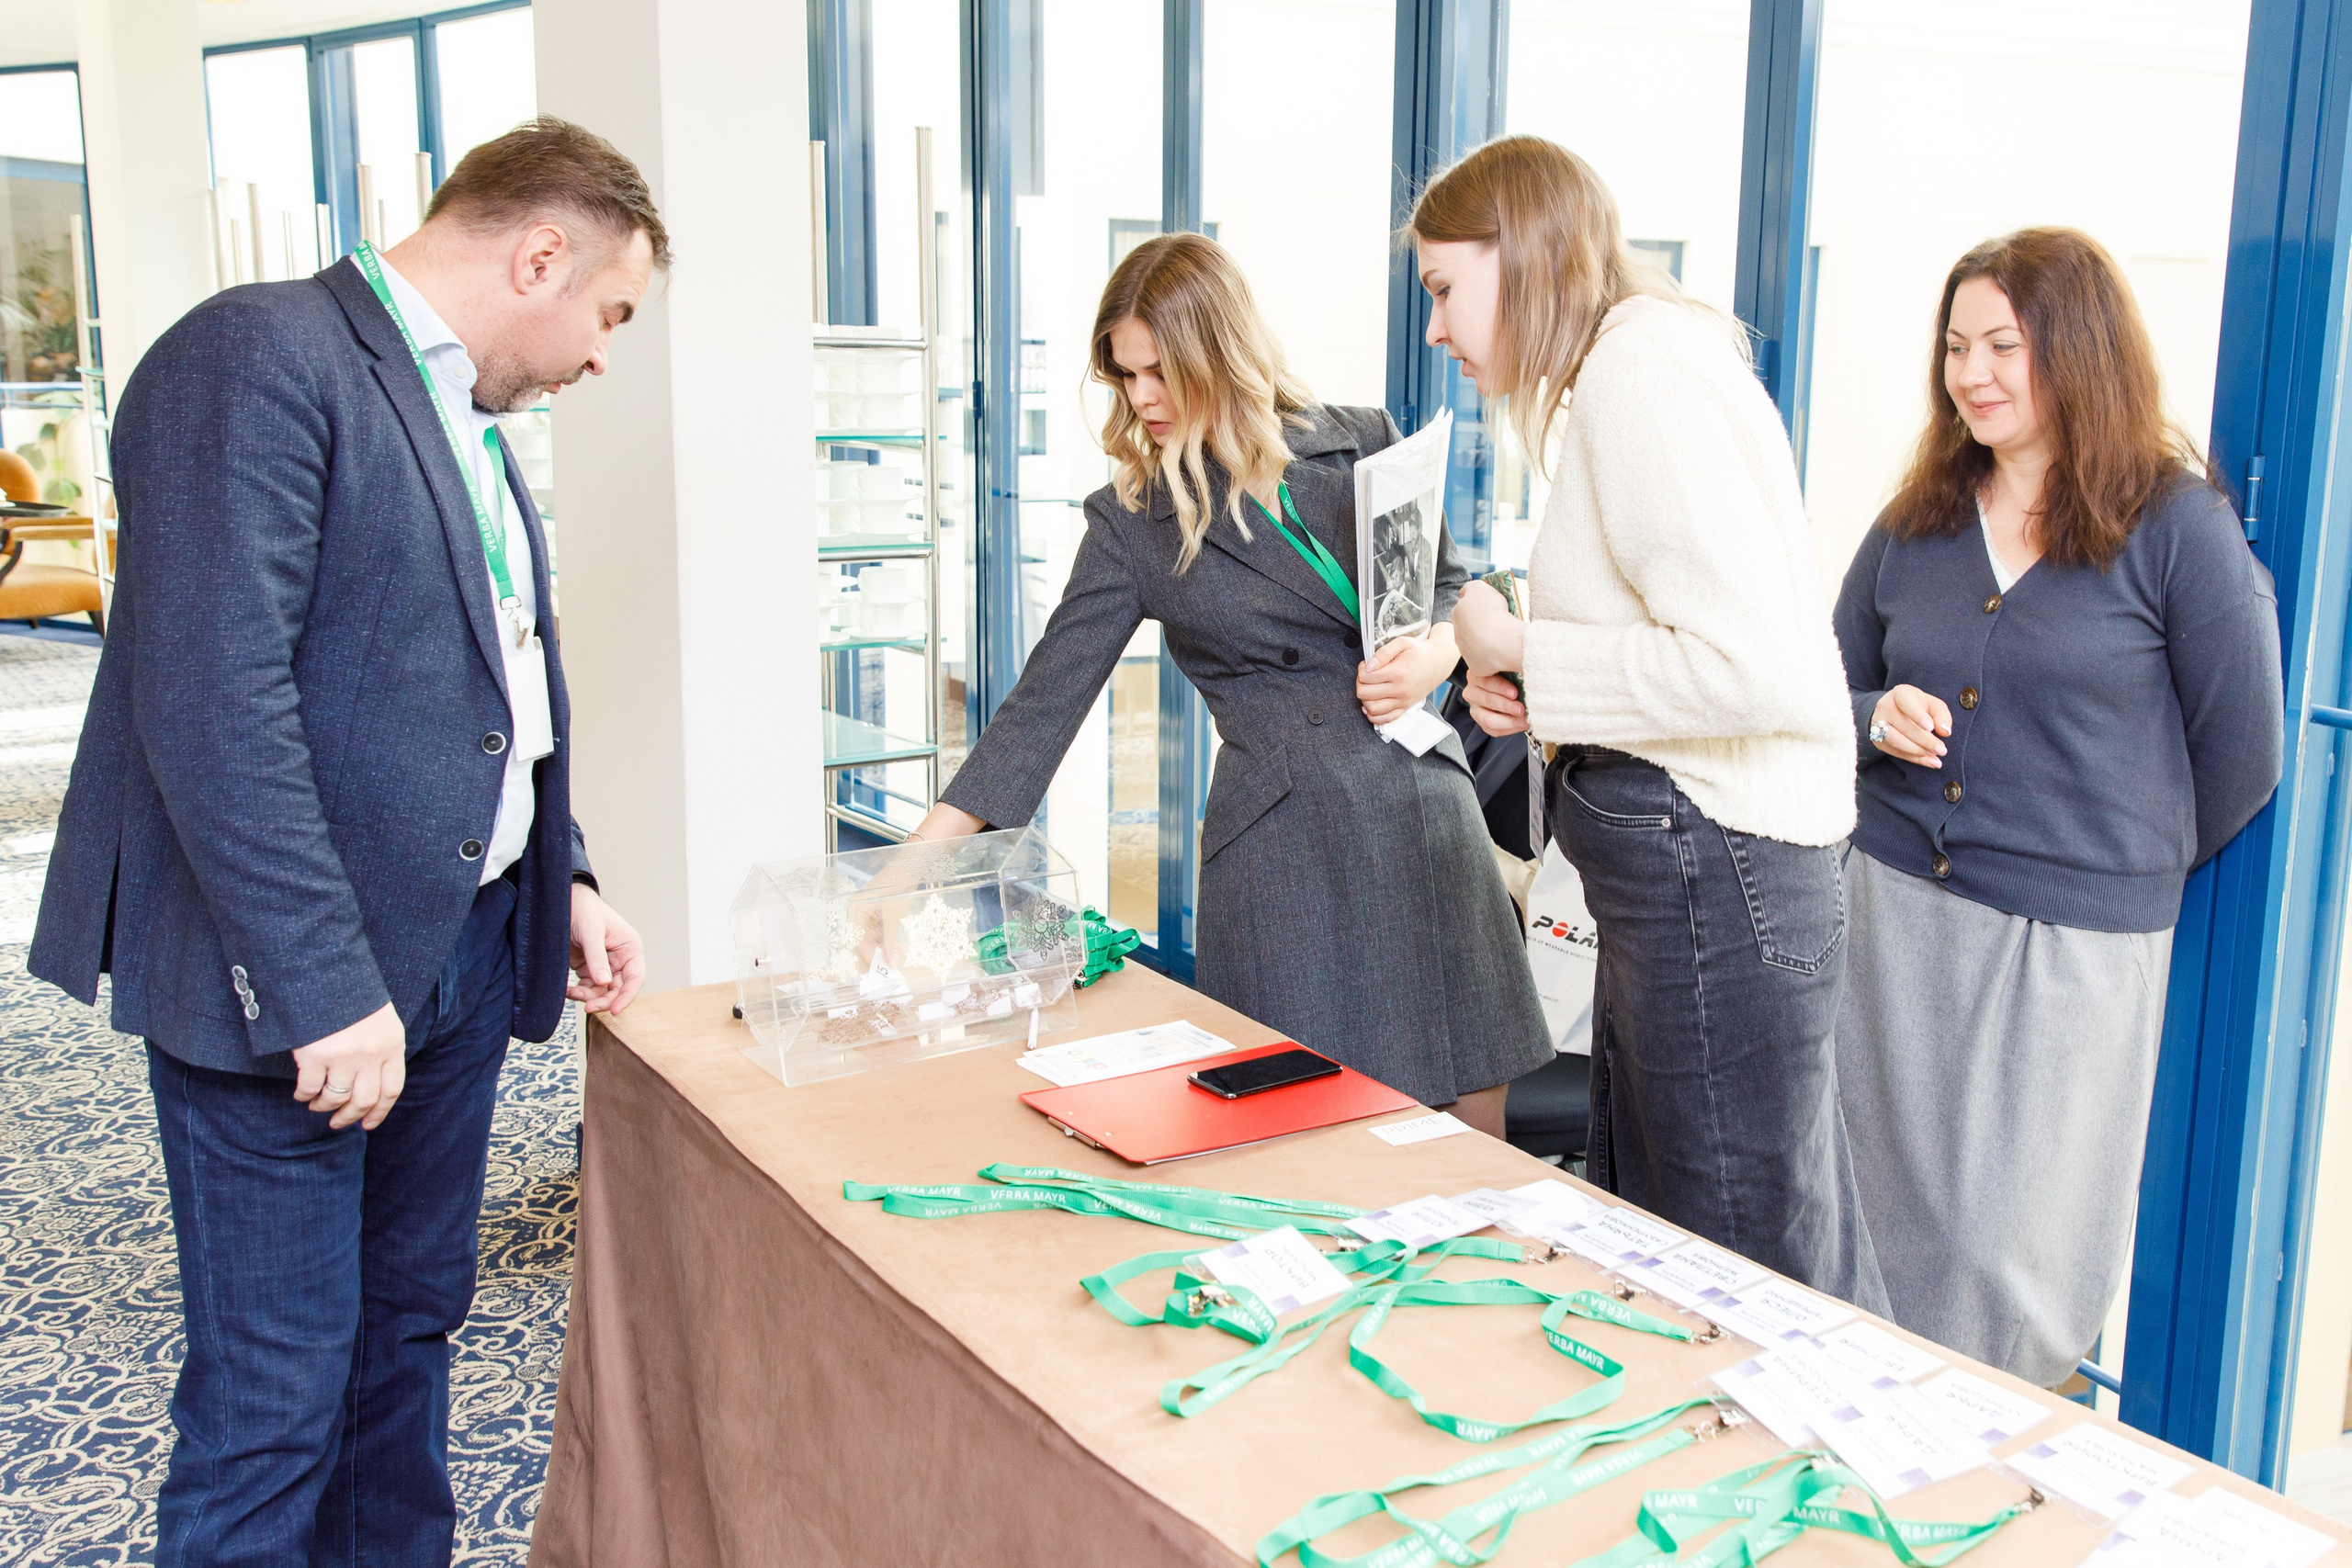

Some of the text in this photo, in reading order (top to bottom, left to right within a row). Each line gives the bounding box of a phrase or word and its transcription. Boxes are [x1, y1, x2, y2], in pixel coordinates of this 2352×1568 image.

[361, 248, 380, 280] VERBA
[384, 300, 405, 330] MAYR
[469, 484, 497, 553] VERBA MAYR
[1023, 1168, 1093, 1182] VERBA MAYR
[887, 1186, 961, 1196] VERBA MAYR
[990, 1190, 1067, 1203] VERBA MAYR
[924, 1201, 1002, 1217] VERBA MAYR
[1126, 1201, 1161, 1221] VERBA
[1189, 1221, 1255, 1239] RBA MAYR
[1595, 1220, 1652, 1247] ТАТЬЯНА
[1261, 1247, 1309, 1289] ВИКТОР
[1670, 1252, 1739, 1285] СВЕТЛАНА
[1247, 1295, 1275, 1332] MAYR
[1590, 1295, 1631, 1323] VERBA
[1758, 1297, 1810, 1321] ОЛЕСЯ
[1576, 1345, 1604, 1371] MAYR
[1770, 1354, 1836, 1405] АТЕРИНА
[1944, 1391, 2005, 1418] ДАРЬЯ
[1455, 1420, 1498, 1440] MAYR
[1883, 1413, 1939, 1456] ДАРЬЯ
[2060, 1438, 2159, 1487] ВИКТОРИЯ
[1655, 1494, 1698, 1509] MAYR
